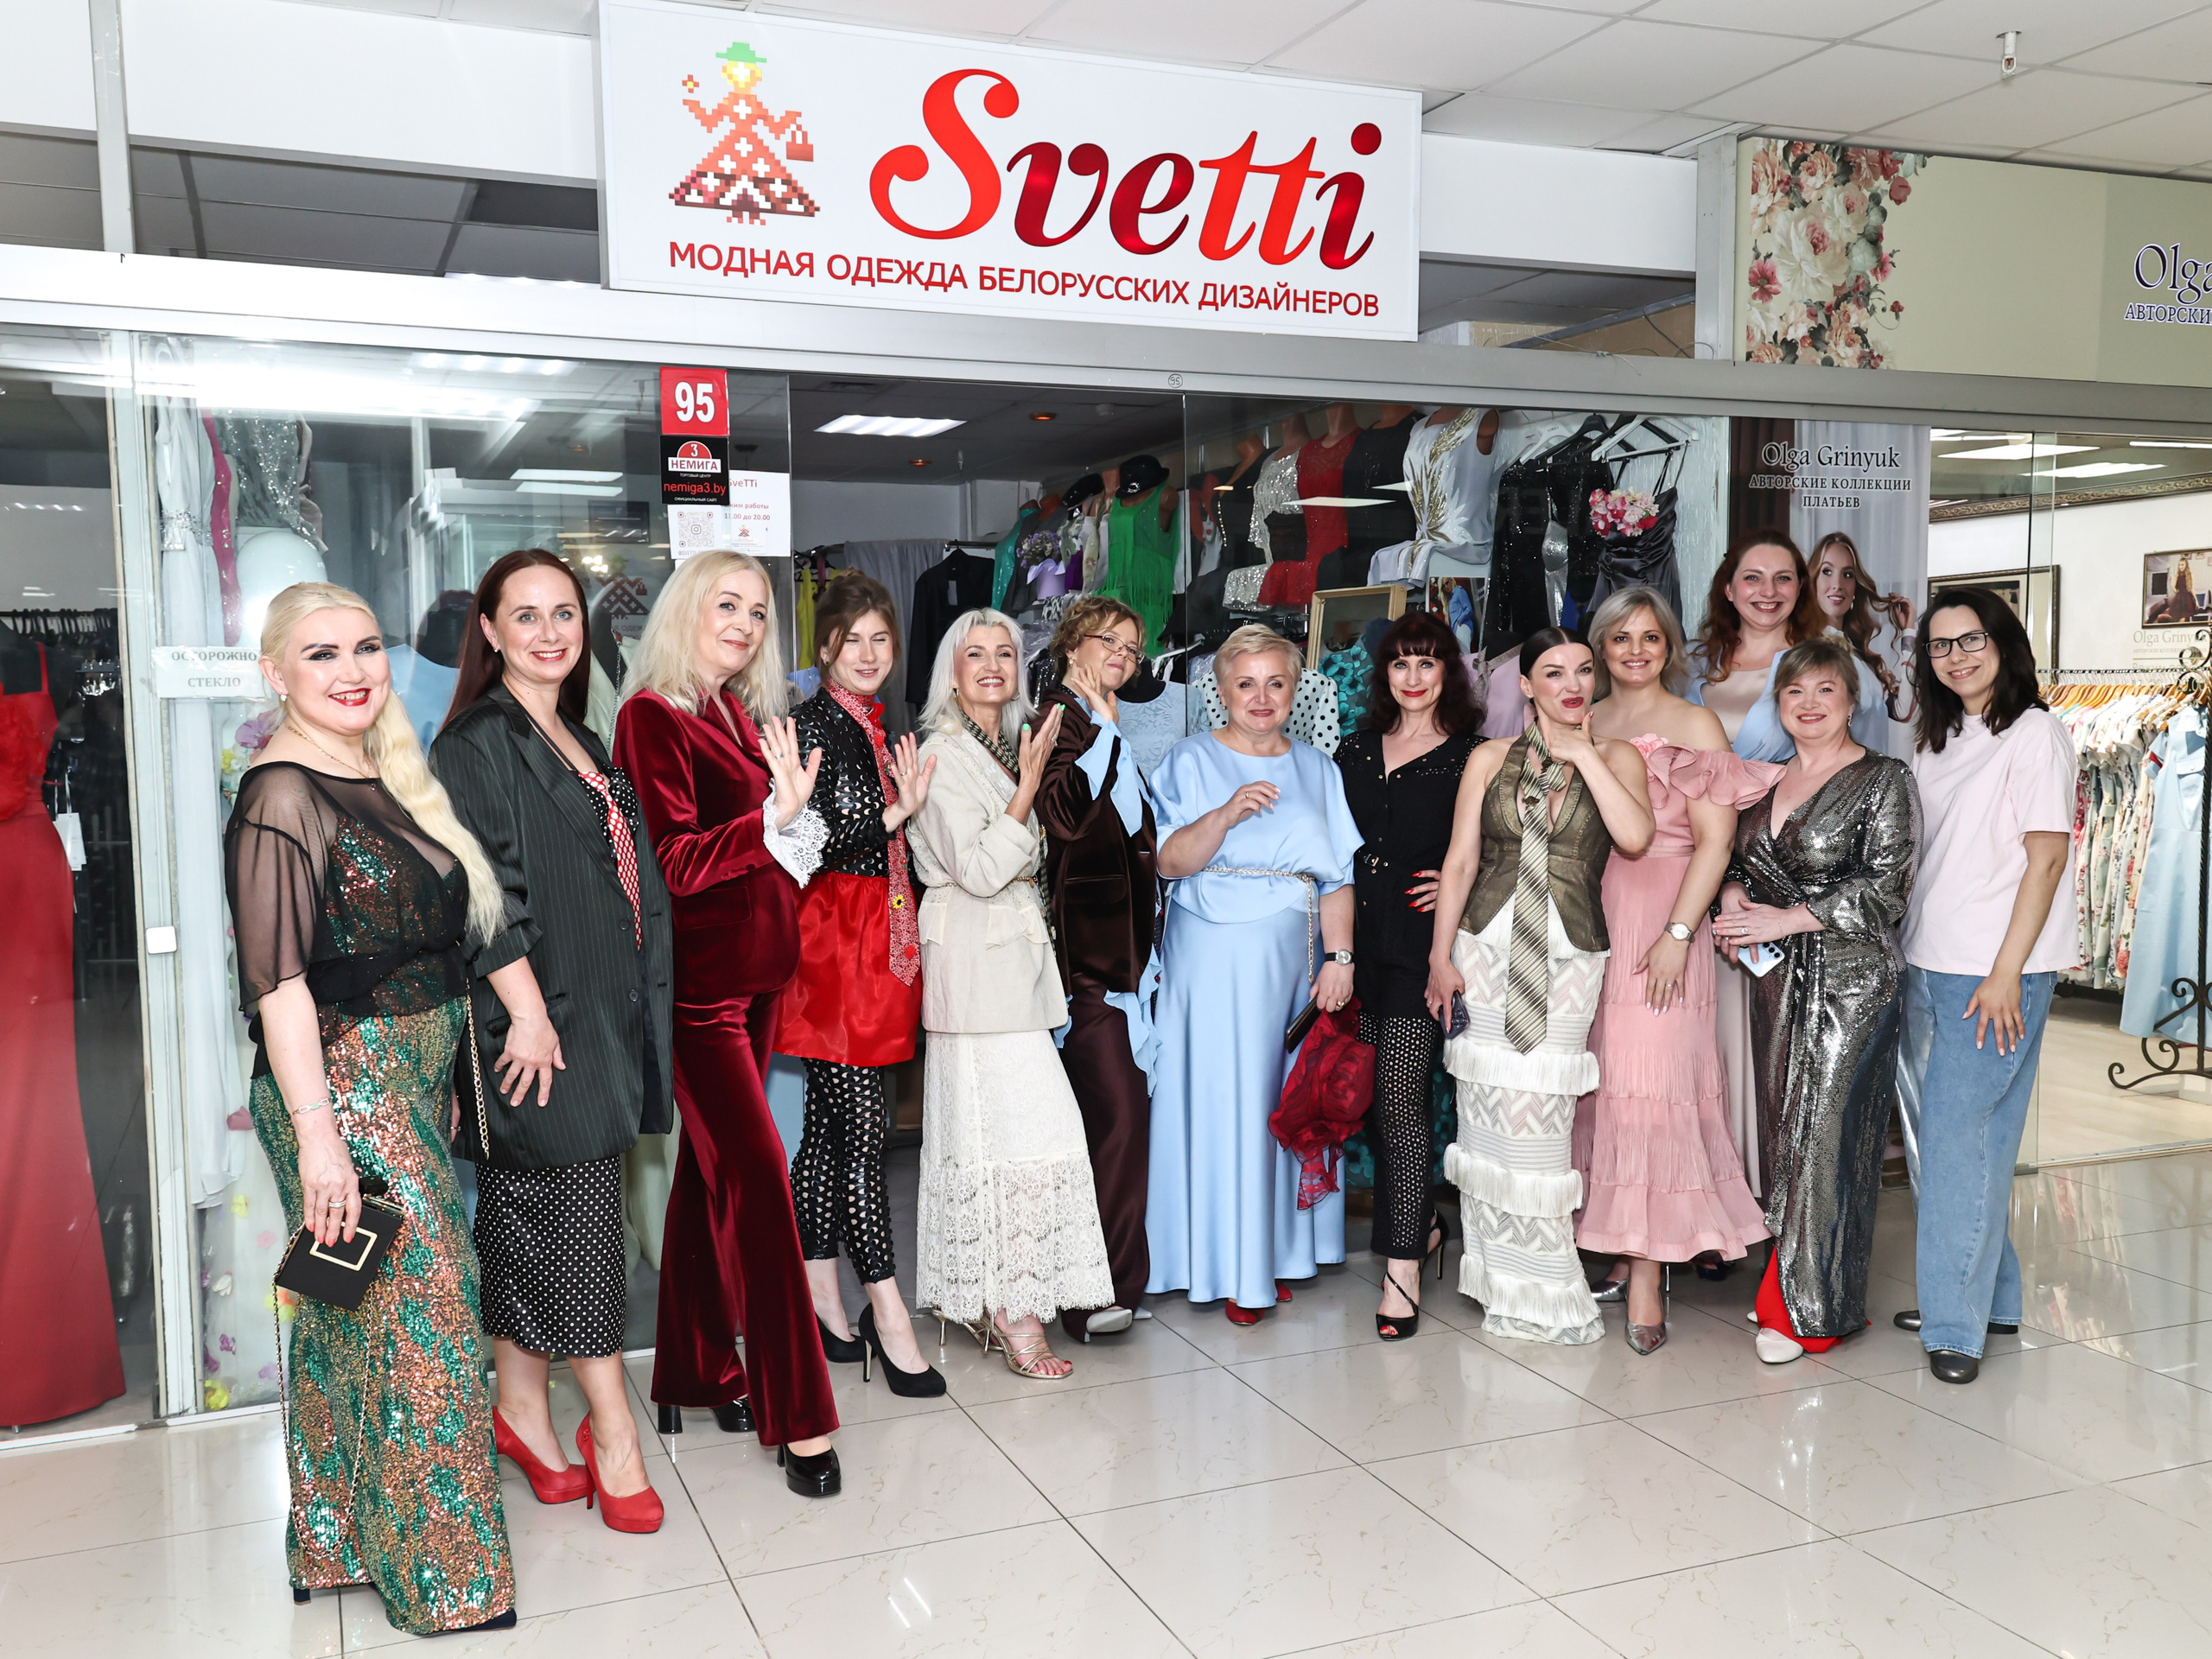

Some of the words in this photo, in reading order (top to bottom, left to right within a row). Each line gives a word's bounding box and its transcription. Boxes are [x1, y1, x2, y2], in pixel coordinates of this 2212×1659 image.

[869, 68, 1382, 270] Svetti
[670, 241, 814, 278] МОДНАЯ
[827, 254, 968, 292] ОДЕЖДА
[979, 265, 1190, 305] БЕЛОРУССКИХ
[1198, 281, 1379, 317] ДИЗАЙНЕРОВ
[2125, 302, 2212, 325] АВТОРСКИ
[675, 381, 715, 423] 95
[690, 443, 699, 457] 3
[1763, 442, 1811, 471] Olga
[1817, 445, 1901, 473] Grinyuk
[671, 459, 718, 471] НЕМИГА
[664, 481, 727, 496] nemiga3.by
[1750, 475, 1827, 489] АВТОРСКИЕ
[1831, 478, 1911, 492] КОЛЛЕКЦИИ
[1802, 495, 1860, 508] ПЛАТЬЕВ
[2133, 631, 2158, 647] Olga
[188, 677, 240, 687] СТЕКЛО
